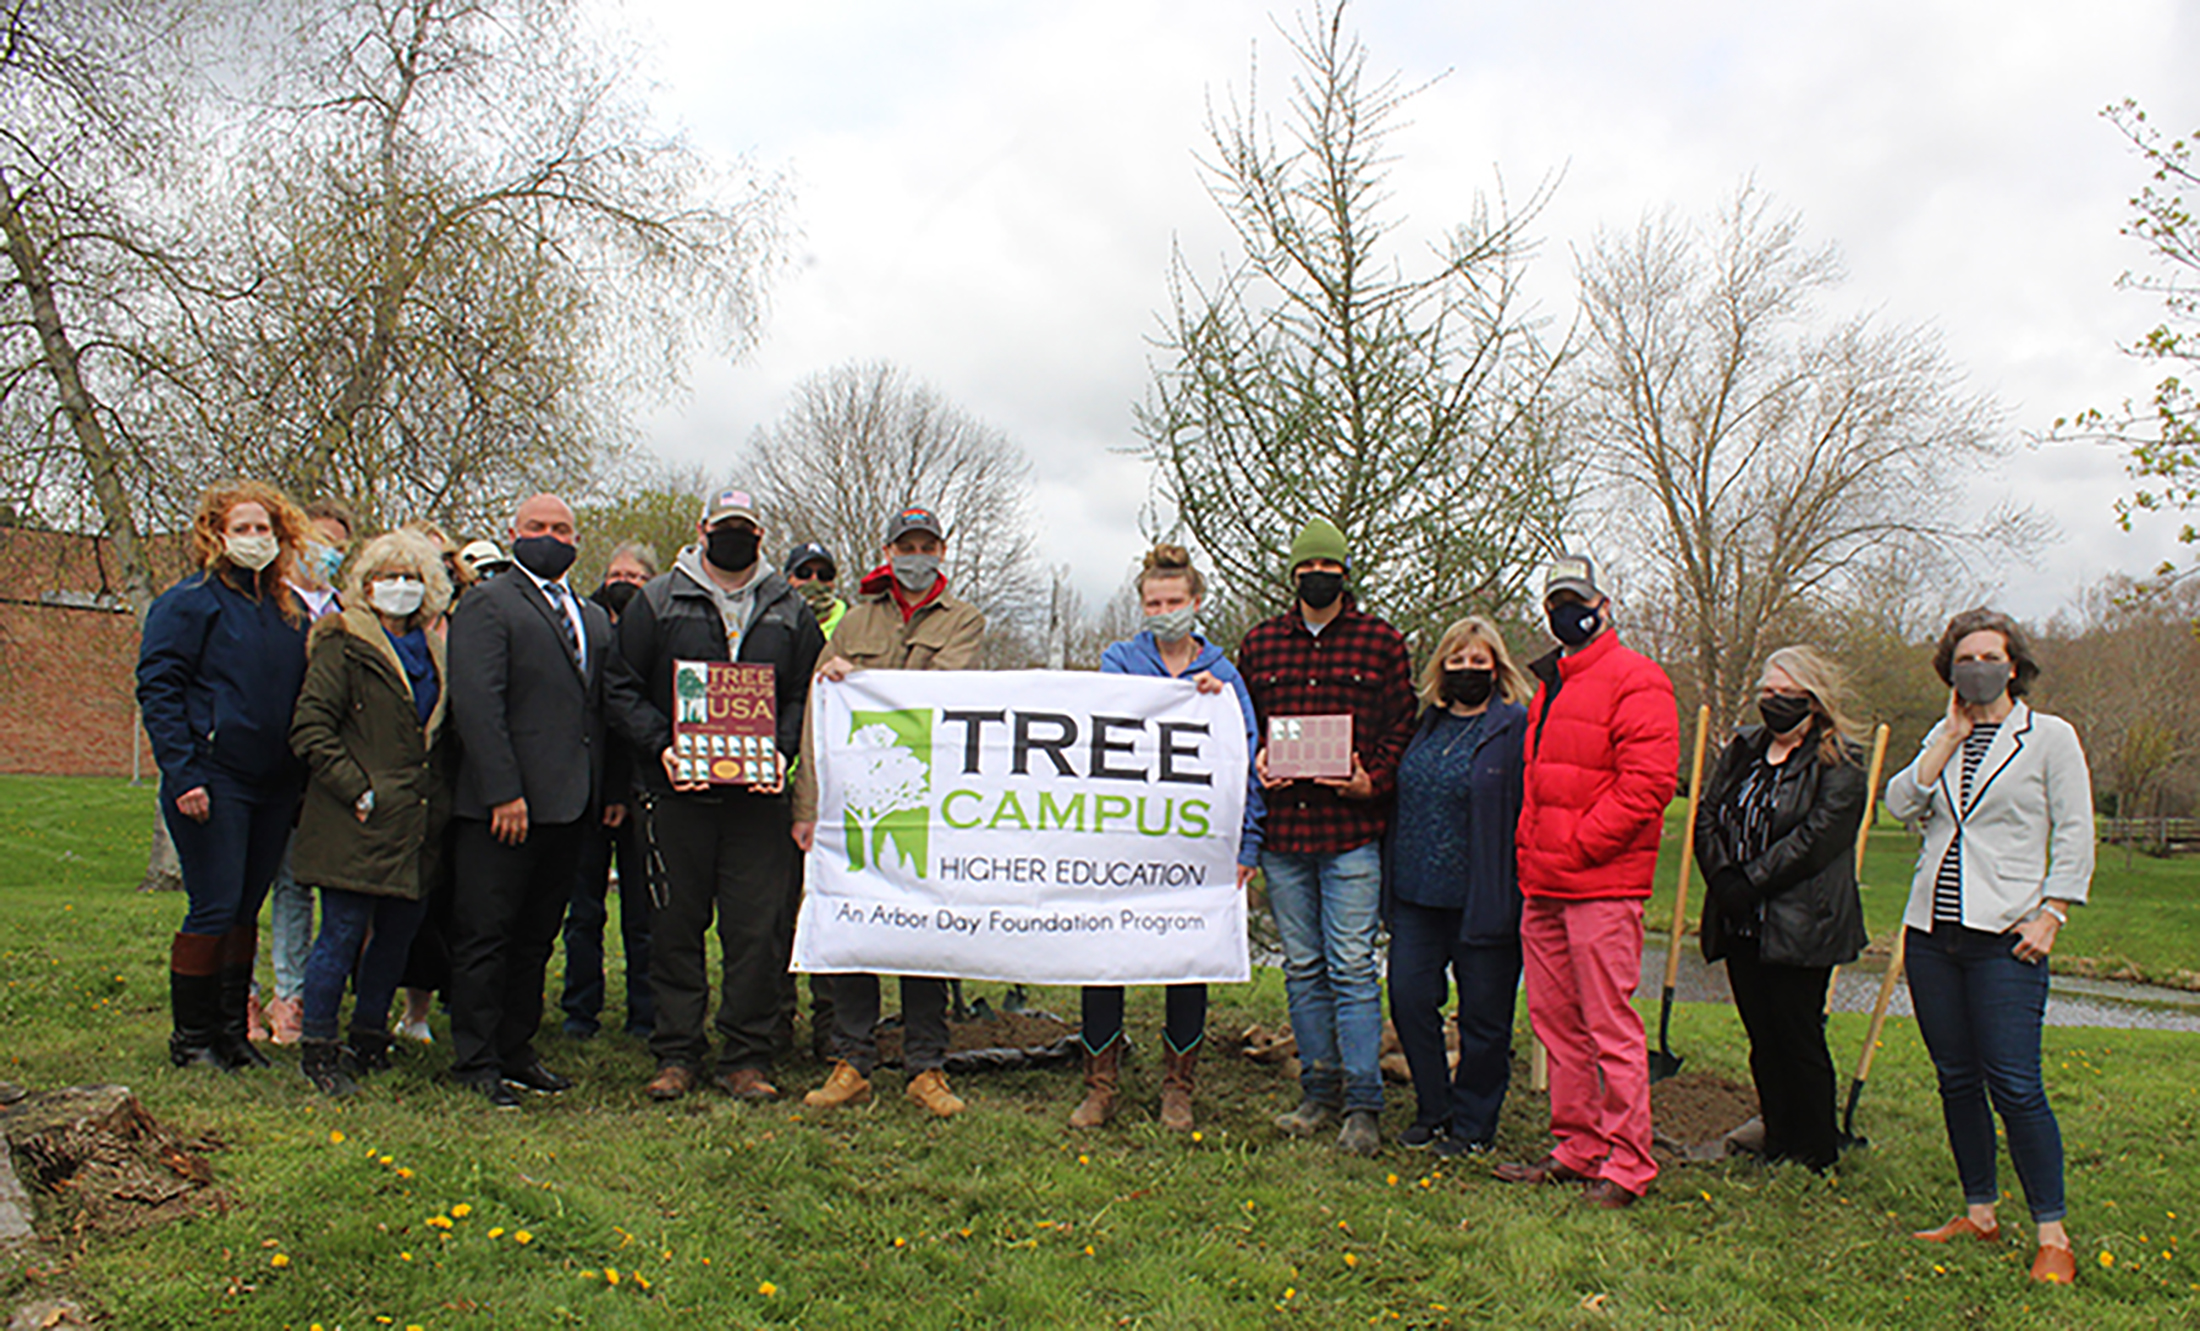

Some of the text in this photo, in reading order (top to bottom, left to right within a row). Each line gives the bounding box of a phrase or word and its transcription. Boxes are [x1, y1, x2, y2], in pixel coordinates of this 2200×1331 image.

[708, 667, 774, 684] TREE
[709, 698, 774, 719] USA
[942, 709, 1213, 786] TREE
[940, 789, 1211, 838] CAMPUS
[940, 857, 1206, 886] HIGHER EDUCATION
[836, 902, 1206, 935] An Arbor Day Foundation Program
